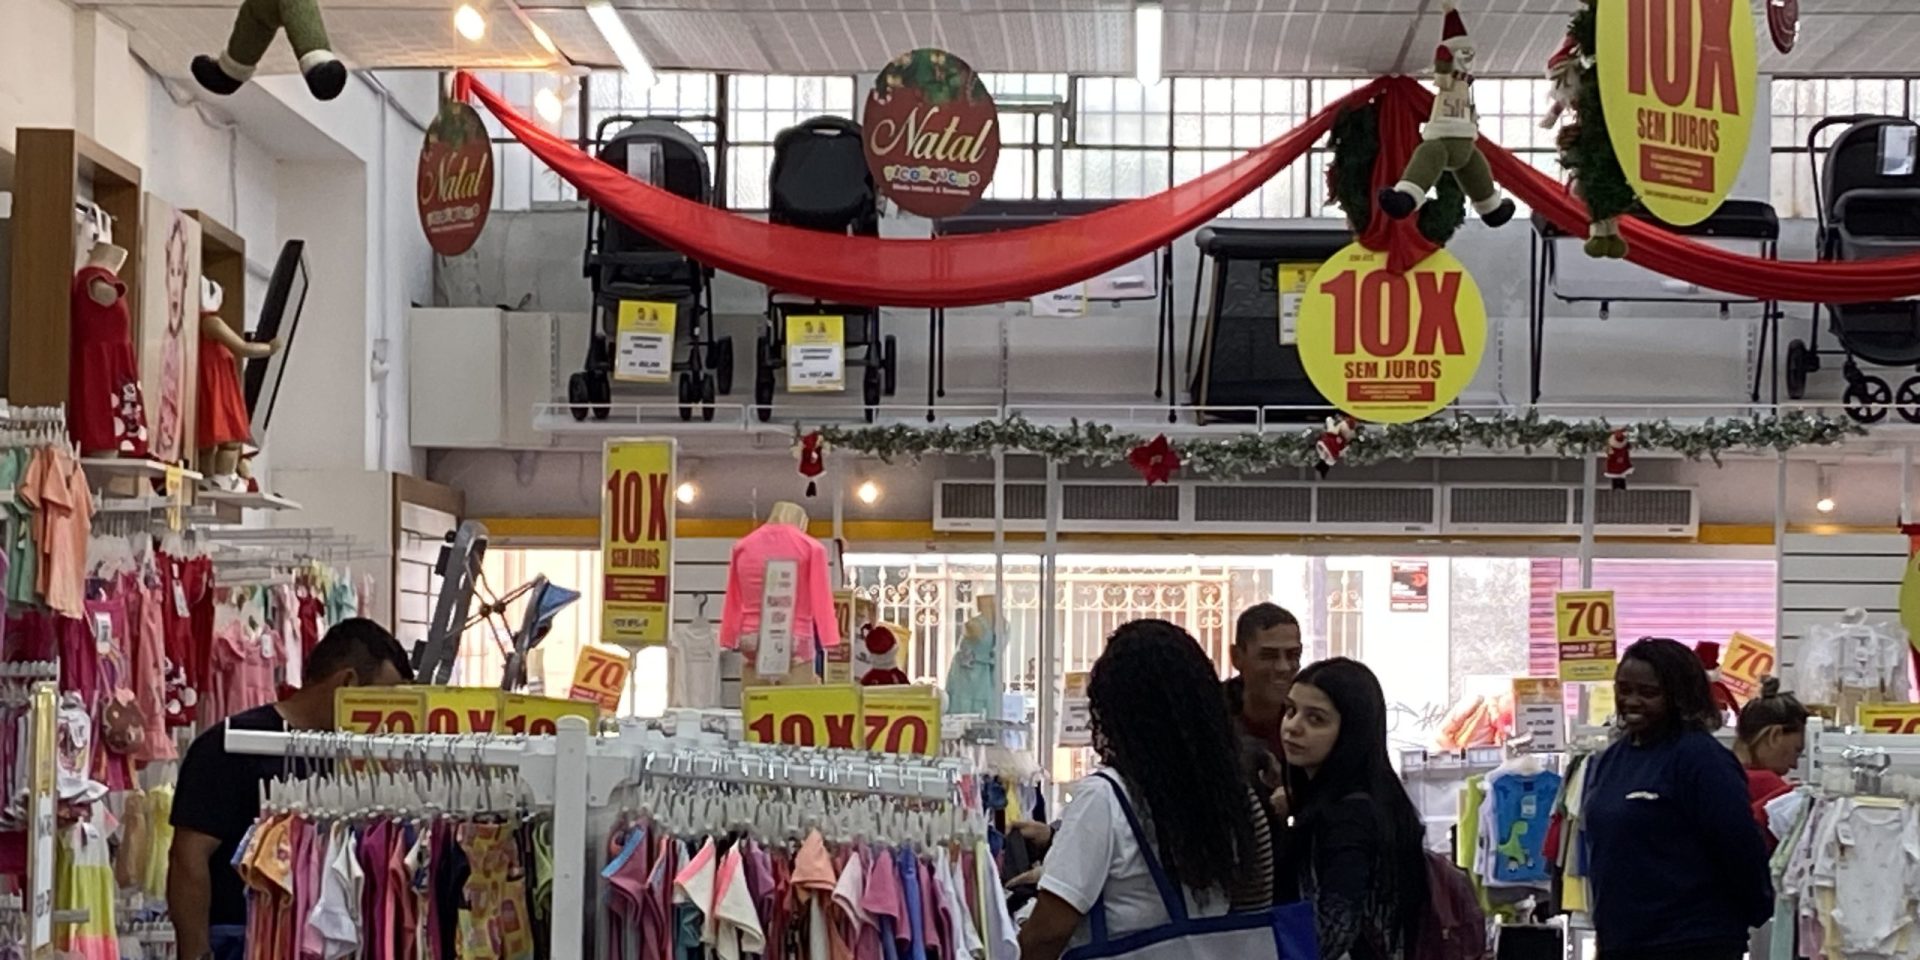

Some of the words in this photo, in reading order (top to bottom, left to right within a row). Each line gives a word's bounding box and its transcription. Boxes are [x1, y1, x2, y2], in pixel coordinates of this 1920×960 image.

[1627, 0, 1741, 116] 10X
[870, 106, 987, 164] Natal
[1637, 106, 1666, 142] SEM
[1670, 111, 1720, 153] JUROS
[420, 151, 489, 205] Natal
[1320, 268, 1466, 358] 10X
[1344, 361, 1379, 379] SEM
[1384, 359, 1442, 379] JUROS
[611, 547, 629, 569] SEM
[630, 547, 661, 570] JUROS
[1566, 601, 1610, 637] 70
[581, 655, 625, 689] 70
[1730, 643, 1774, 680] 70
